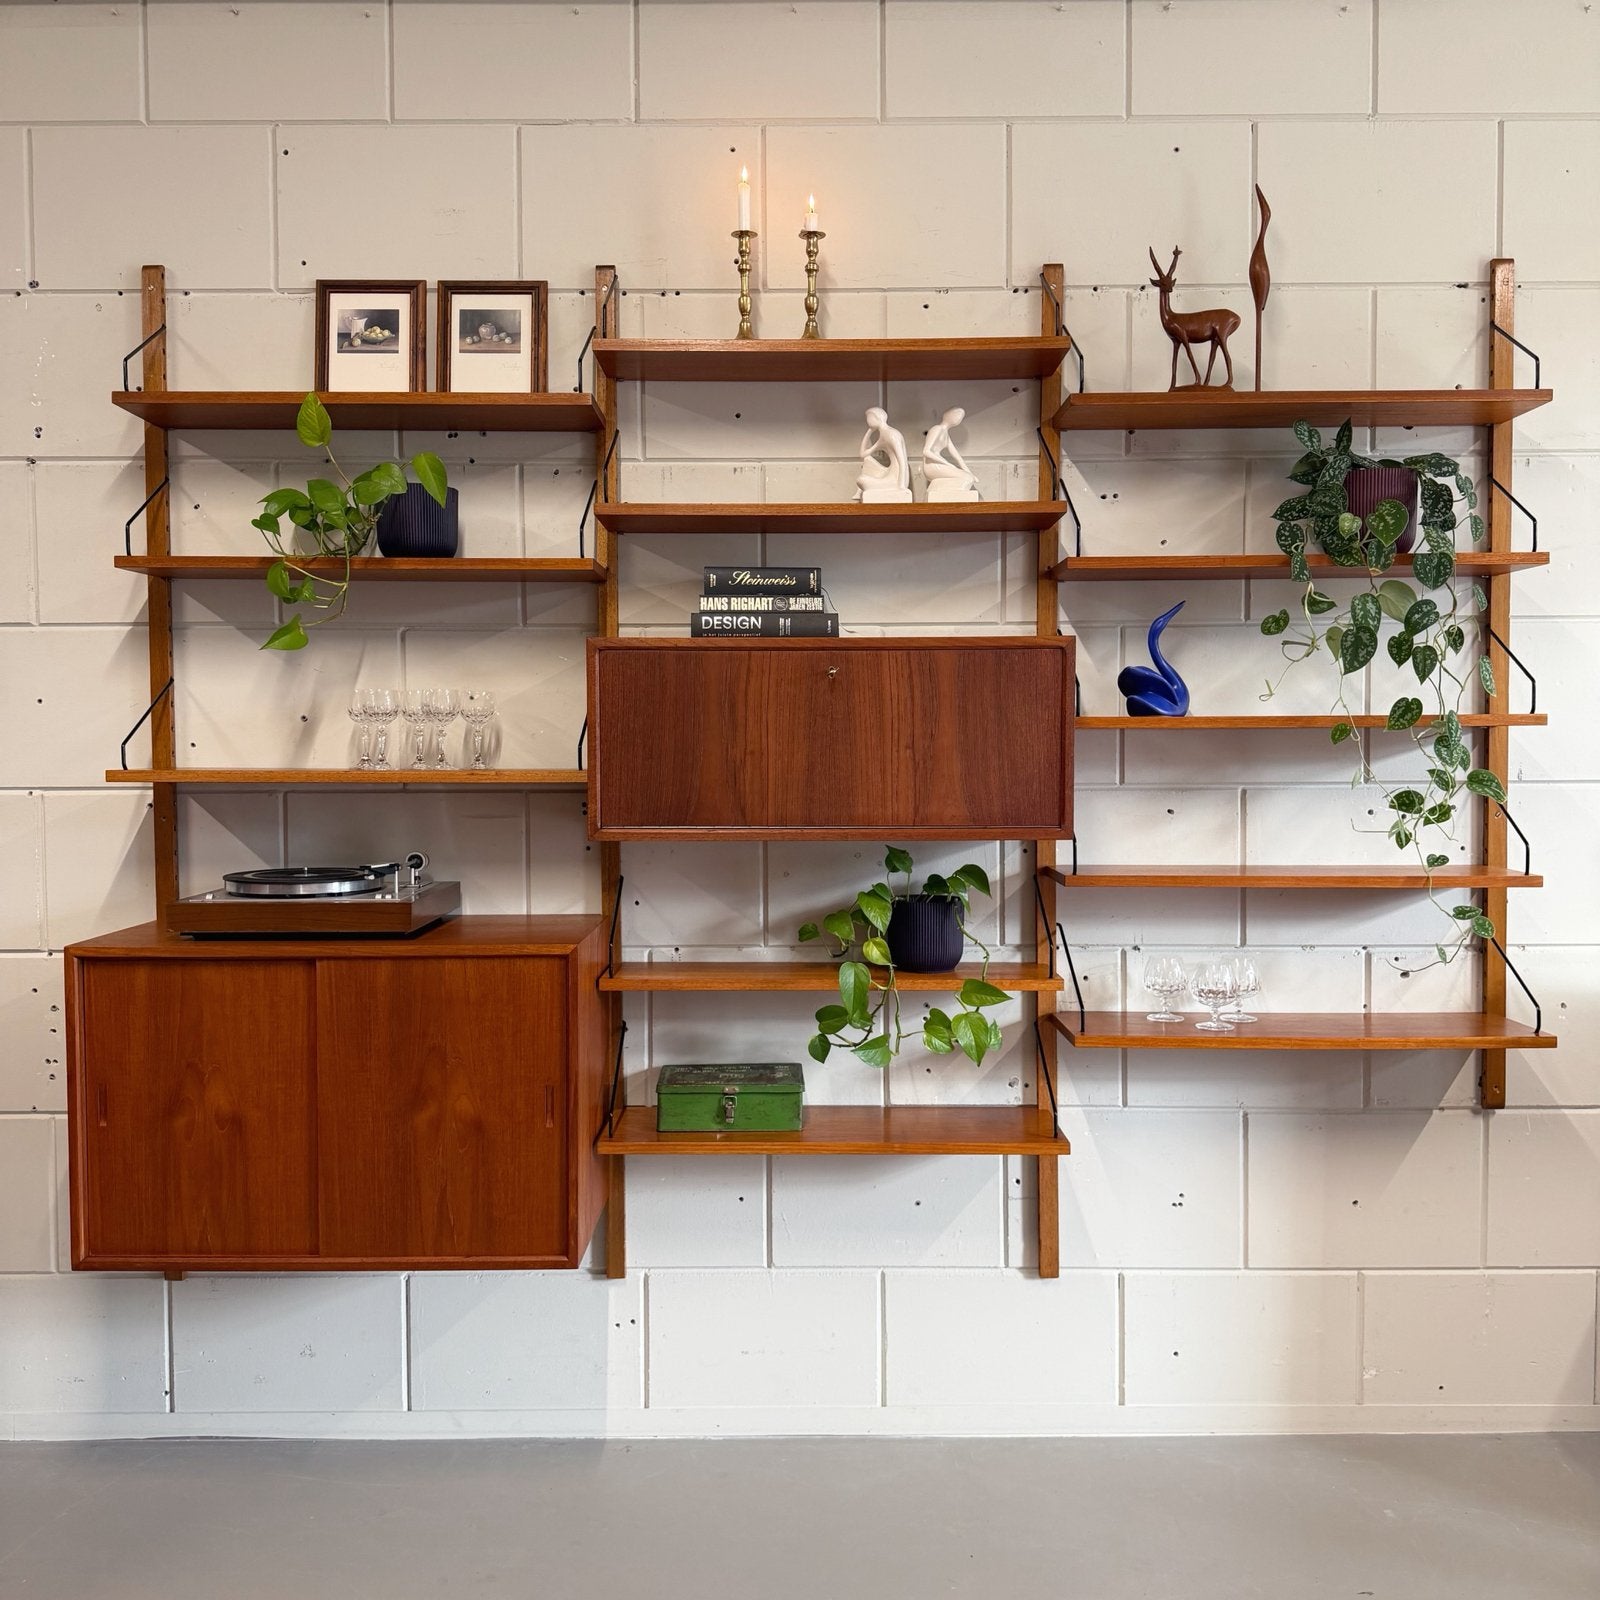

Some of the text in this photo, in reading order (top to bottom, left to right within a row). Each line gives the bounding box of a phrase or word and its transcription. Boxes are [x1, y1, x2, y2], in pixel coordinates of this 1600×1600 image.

[729, 570, 798, 586] Steinweiss
[700, 597, 729, 611] HANS
[731, 597, 774, 611] RIGHART
[701, 616, 762, 630] DESIGN
